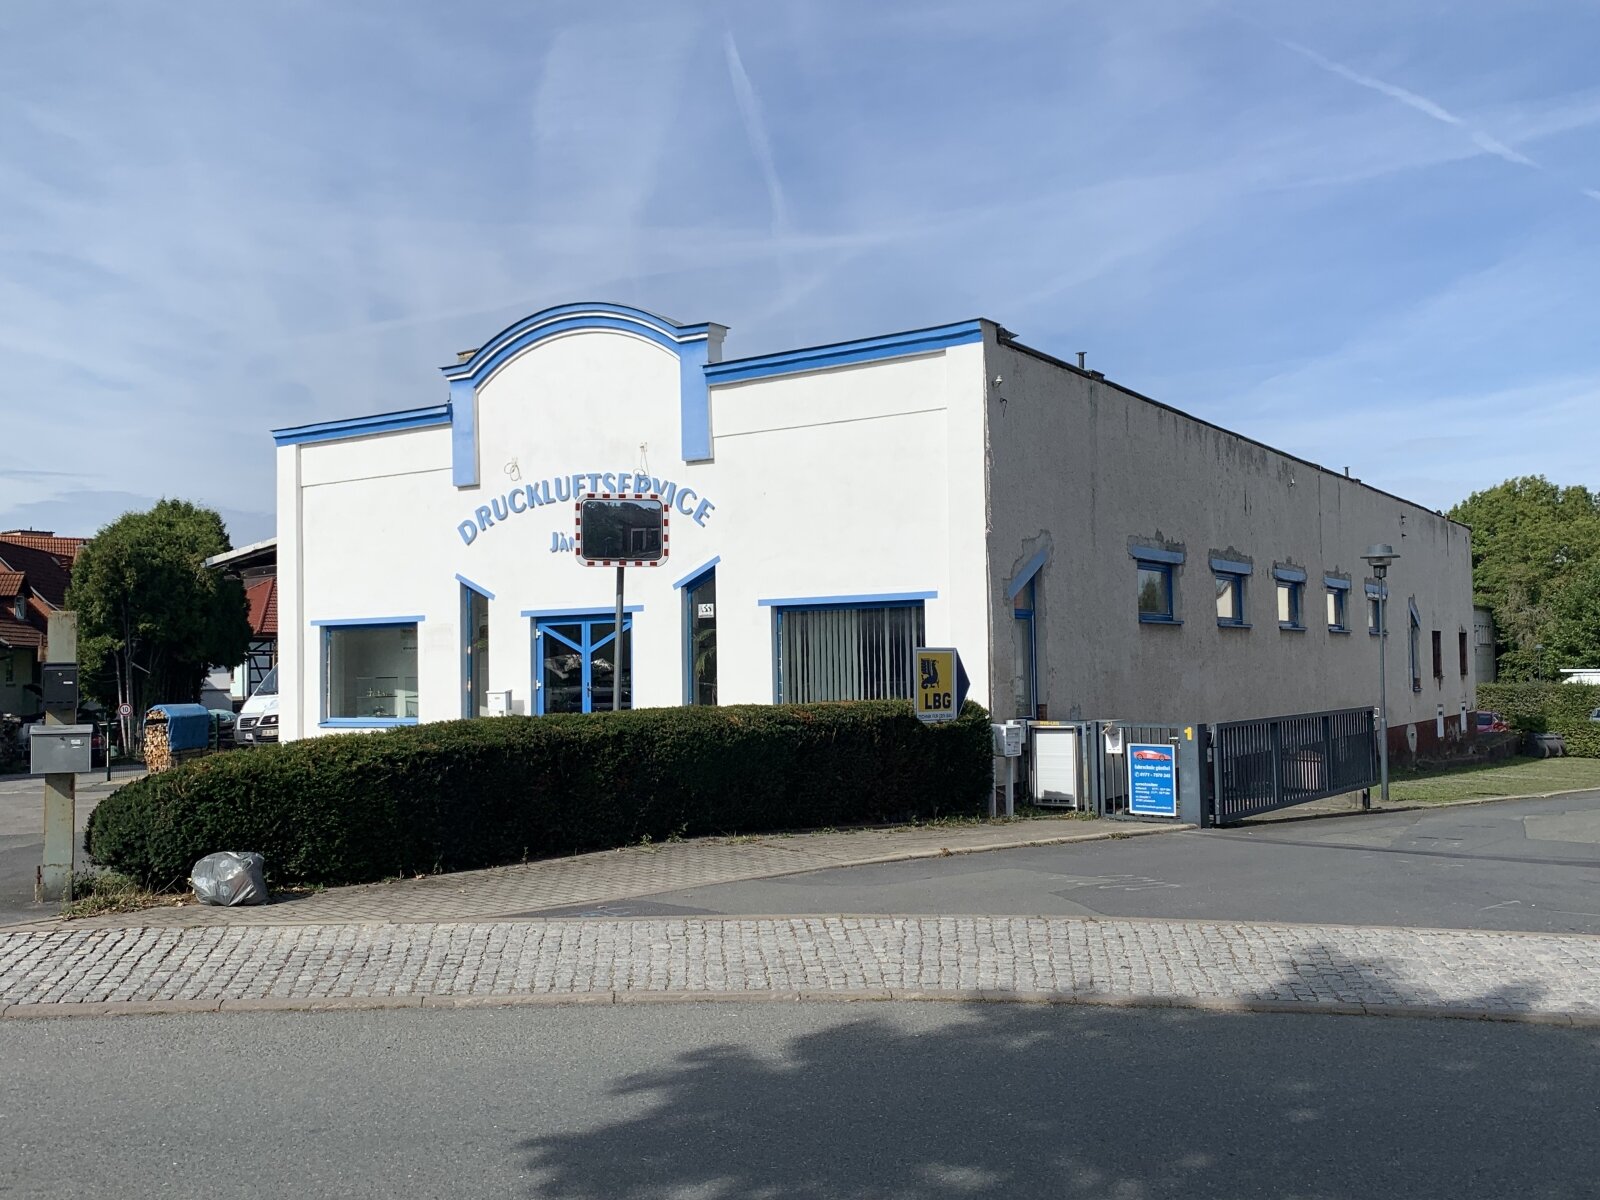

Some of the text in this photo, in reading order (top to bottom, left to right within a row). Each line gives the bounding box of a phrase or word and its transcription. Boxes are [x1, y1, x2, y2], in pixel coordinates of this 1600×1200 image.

[456, 472, 715, 546] DRUCKLUFTSERVICE
[925, 692, 951, 710] LBG
[1184, 726, 1193, 741] 1
